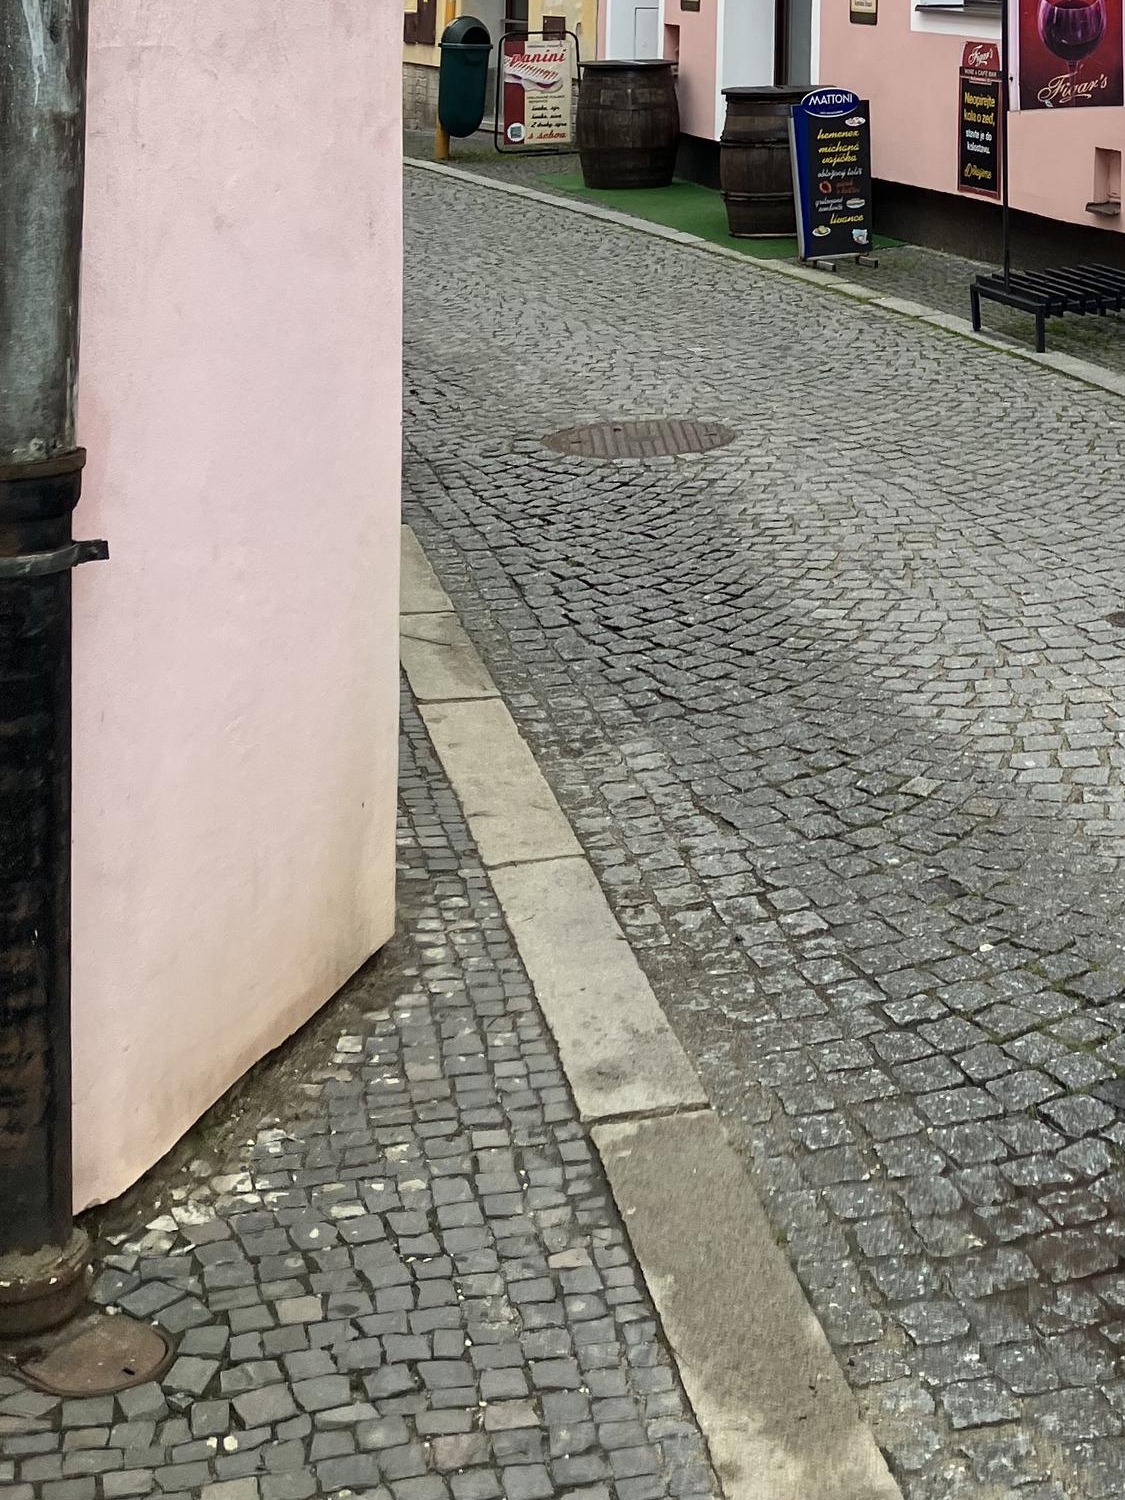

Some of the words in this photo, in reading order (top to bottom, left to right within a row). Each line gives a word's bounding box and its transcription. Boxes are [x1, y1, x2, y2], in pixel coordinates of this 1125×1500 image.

[510, 49, 567, 67] panini
[1038, 71, 1108, 104] Figar's
[809, 93, 853, 106] MATTONI
